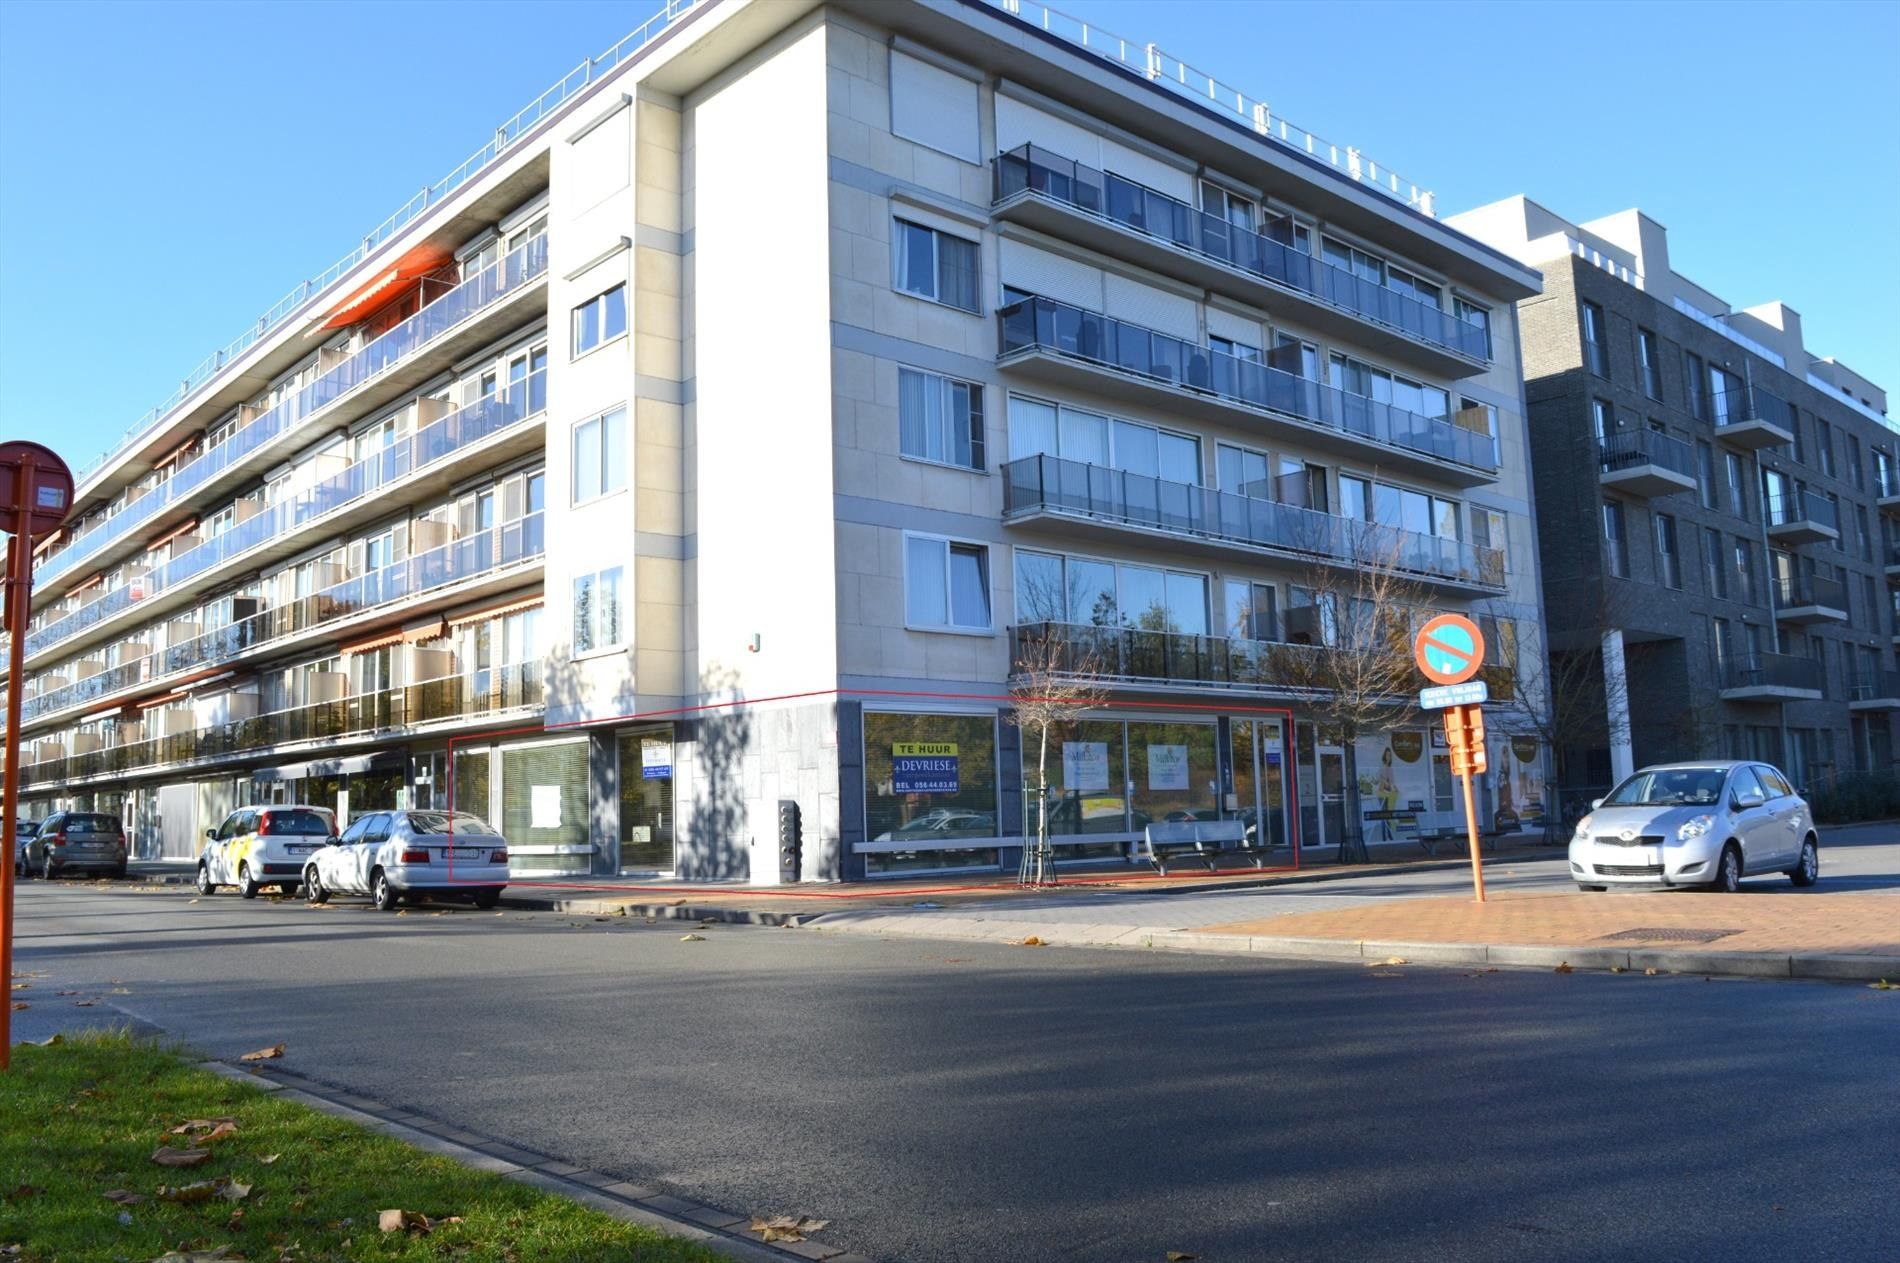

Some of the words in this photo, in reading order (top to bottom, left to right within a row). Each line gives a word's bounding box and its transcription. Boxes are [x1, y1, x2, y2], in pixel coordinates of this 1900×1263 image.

[899, 745, 914, 754] TE
[919, 745, 951, 754] HUUR
[901, 760, 951, 771] DEVRIESE
